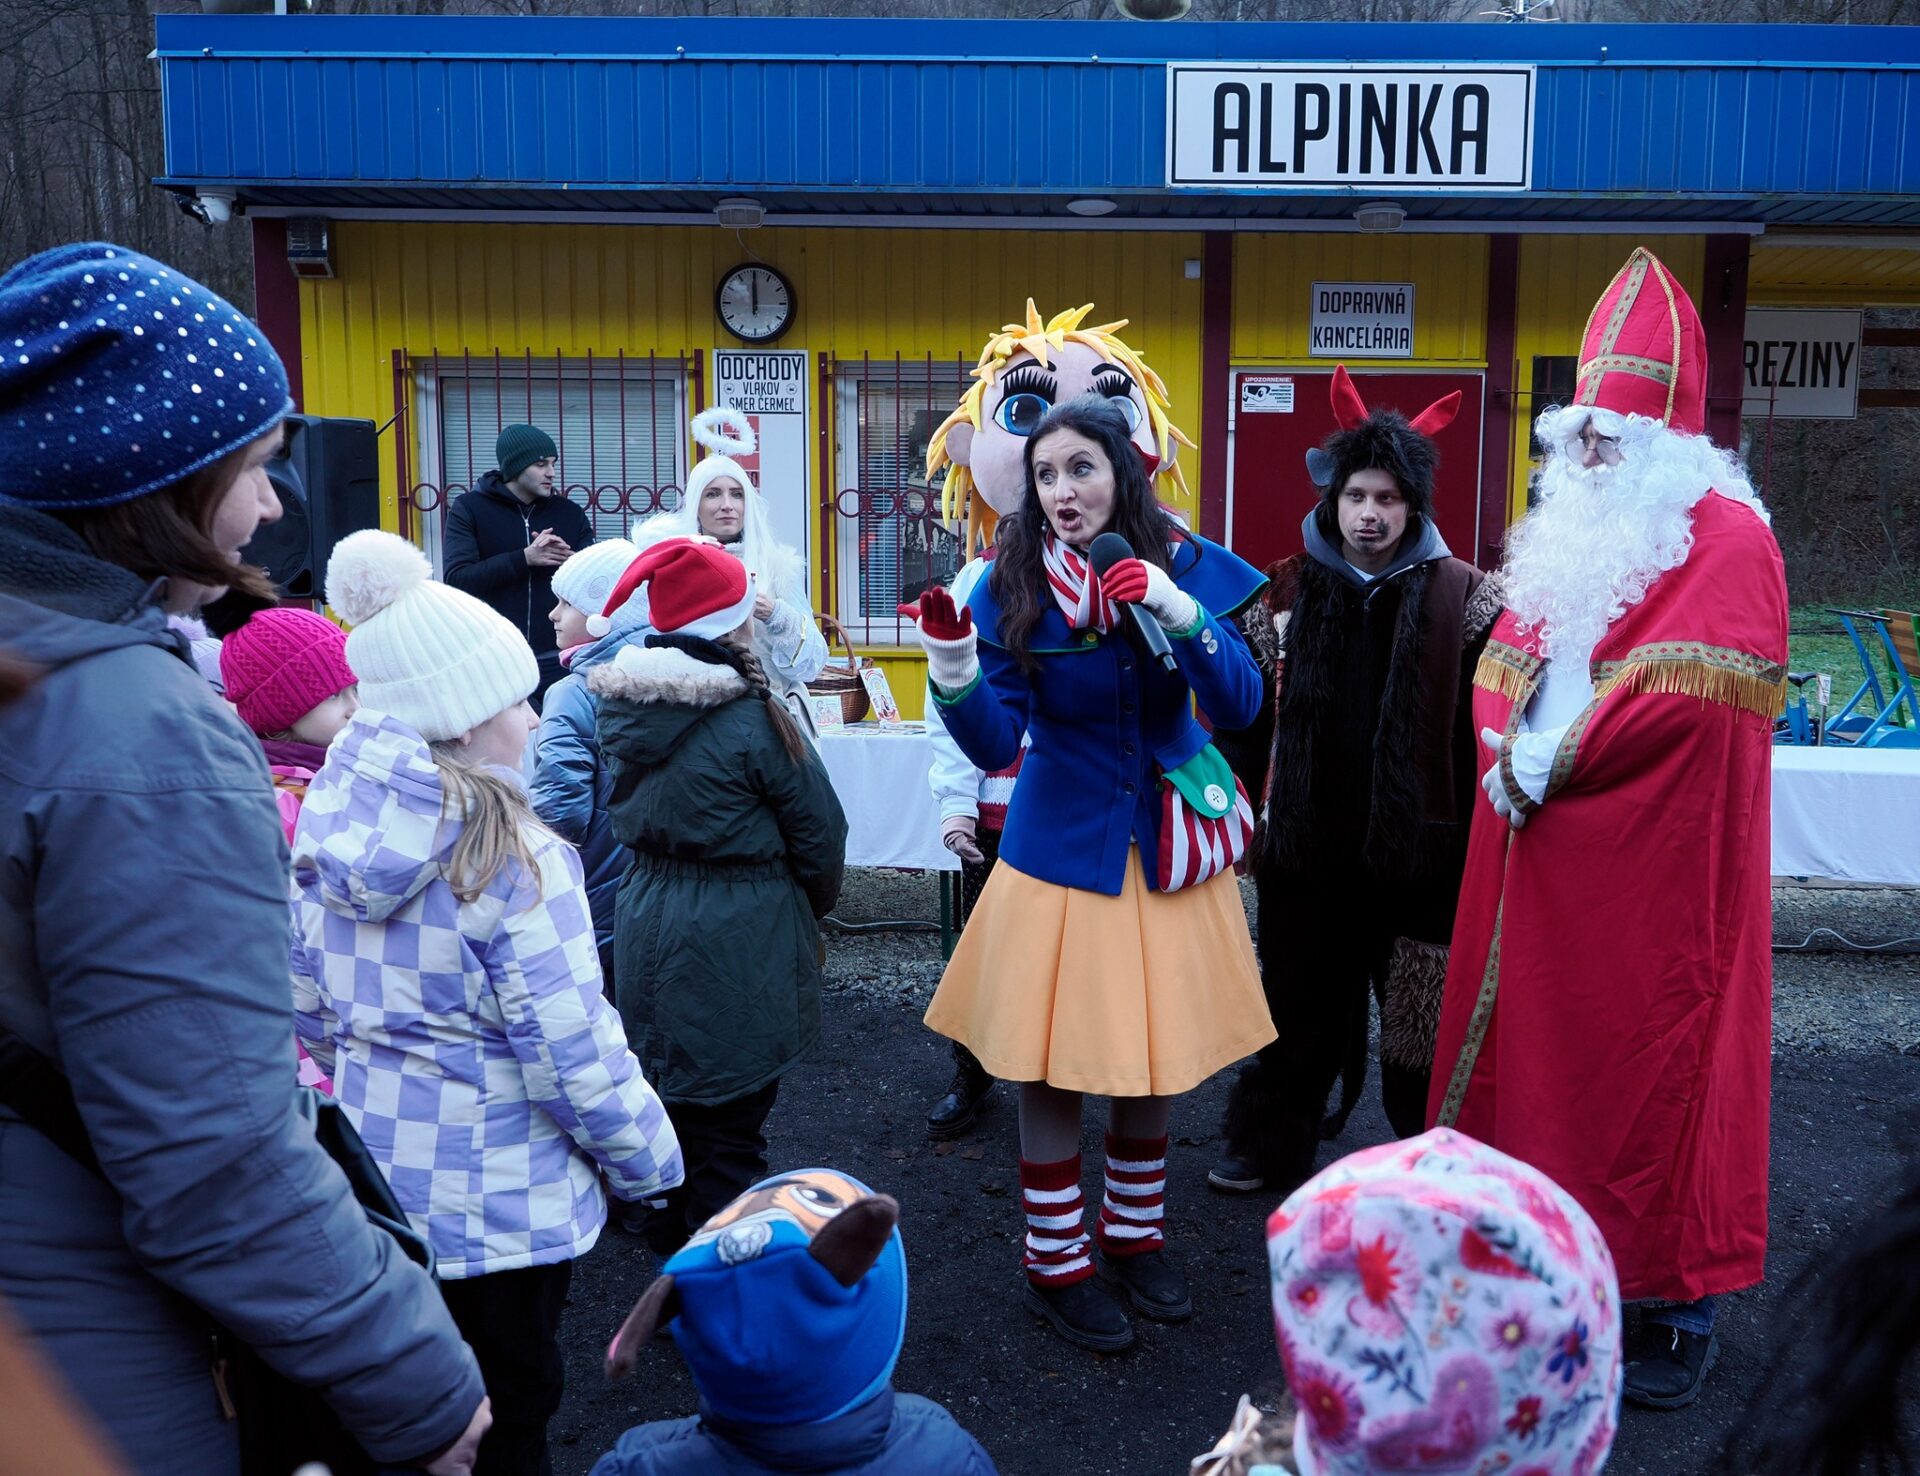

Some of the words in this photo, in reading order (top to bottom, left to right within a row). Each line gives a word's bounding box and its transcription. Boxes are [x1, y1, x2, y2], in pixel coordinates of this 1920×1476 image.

[1212, 82, 1490, 175] ALPINKA
[1319, 288, 1406, 314] DOPRAVNÁ
[1313, 322, 1410, 349] KANCELÁRIA
[721, 357, 802, 380] ODCHODY
[743, 382, 780, 395] VLAKOV
[729, 397, 755, 411] SMER
